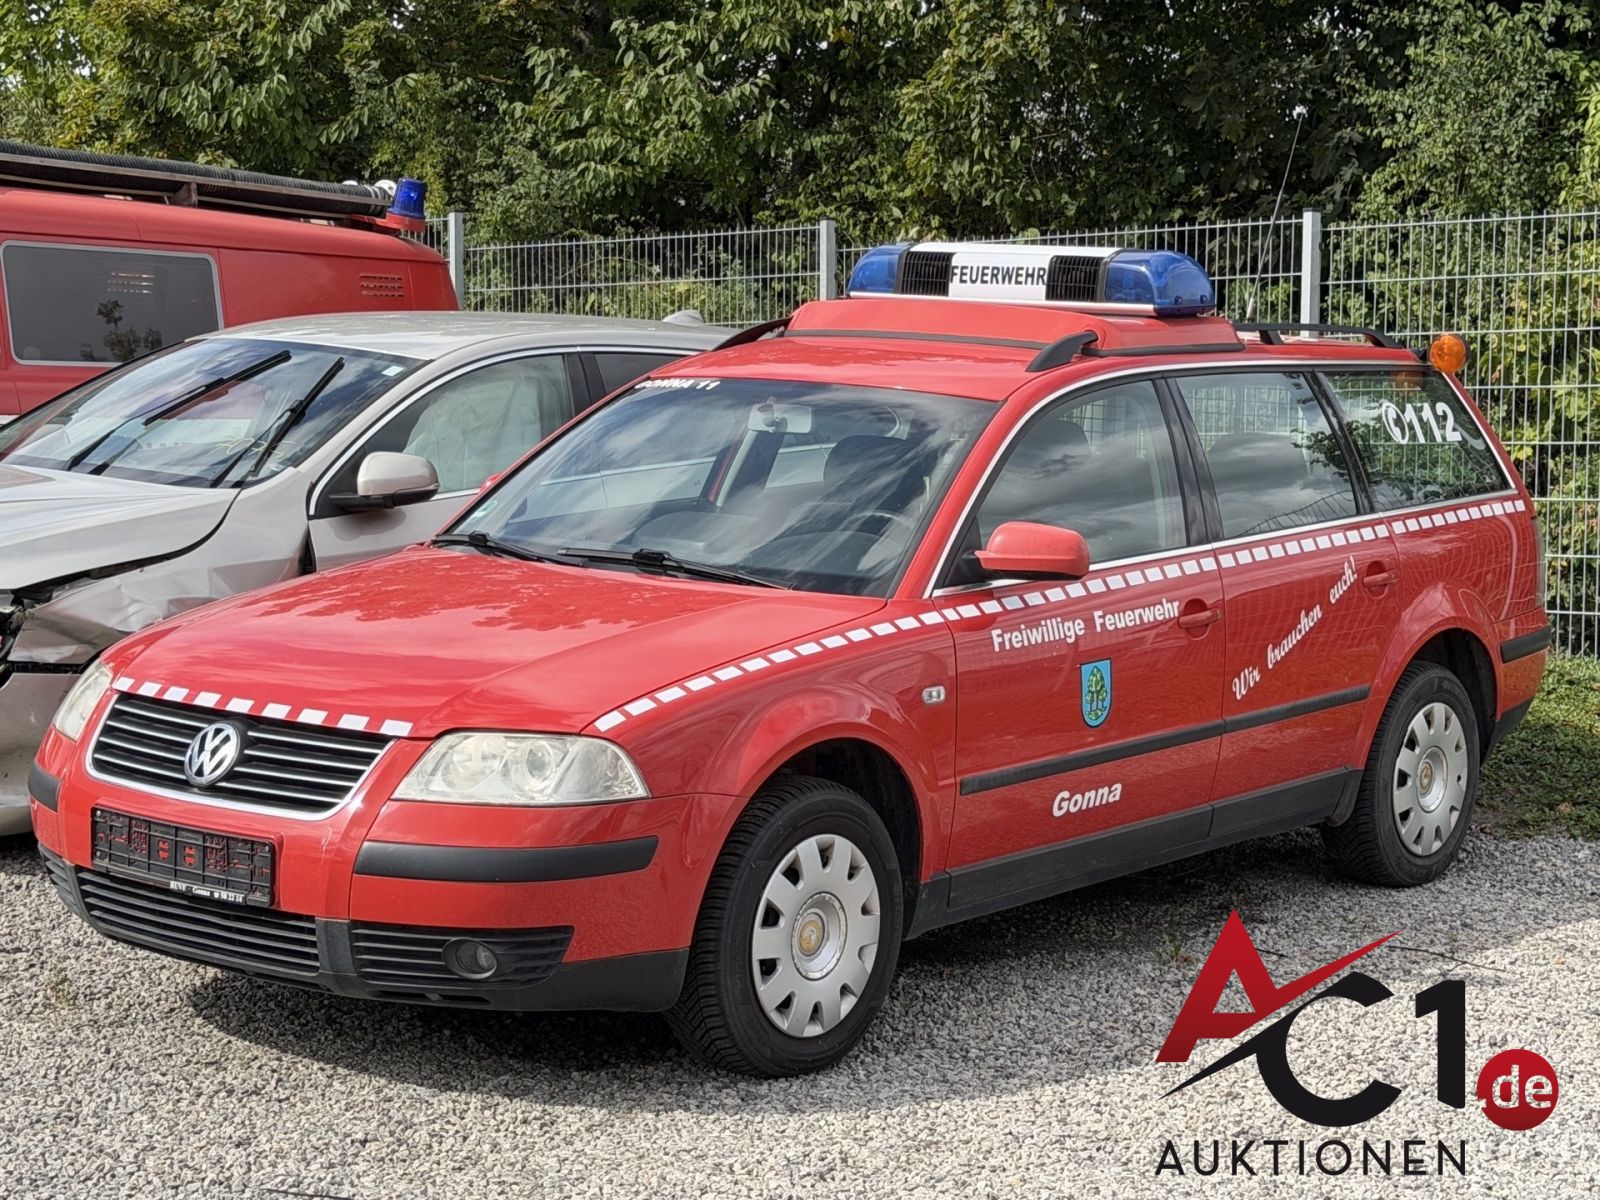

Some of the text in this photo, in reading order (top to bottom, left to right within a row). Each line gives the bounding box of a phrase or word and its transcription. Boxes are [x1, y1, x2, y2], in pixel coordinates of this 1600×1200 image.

[950, 265, 1047, 286] FEUERWEHR
[1404, 402, 1463, 444] 112
[991, 598, 1180, 652] Freiwillige Feuerwehr
[1232, 555, 1358, 700] Wir brauchen euch!
[1052, 783, 1122, 817] Gonna
